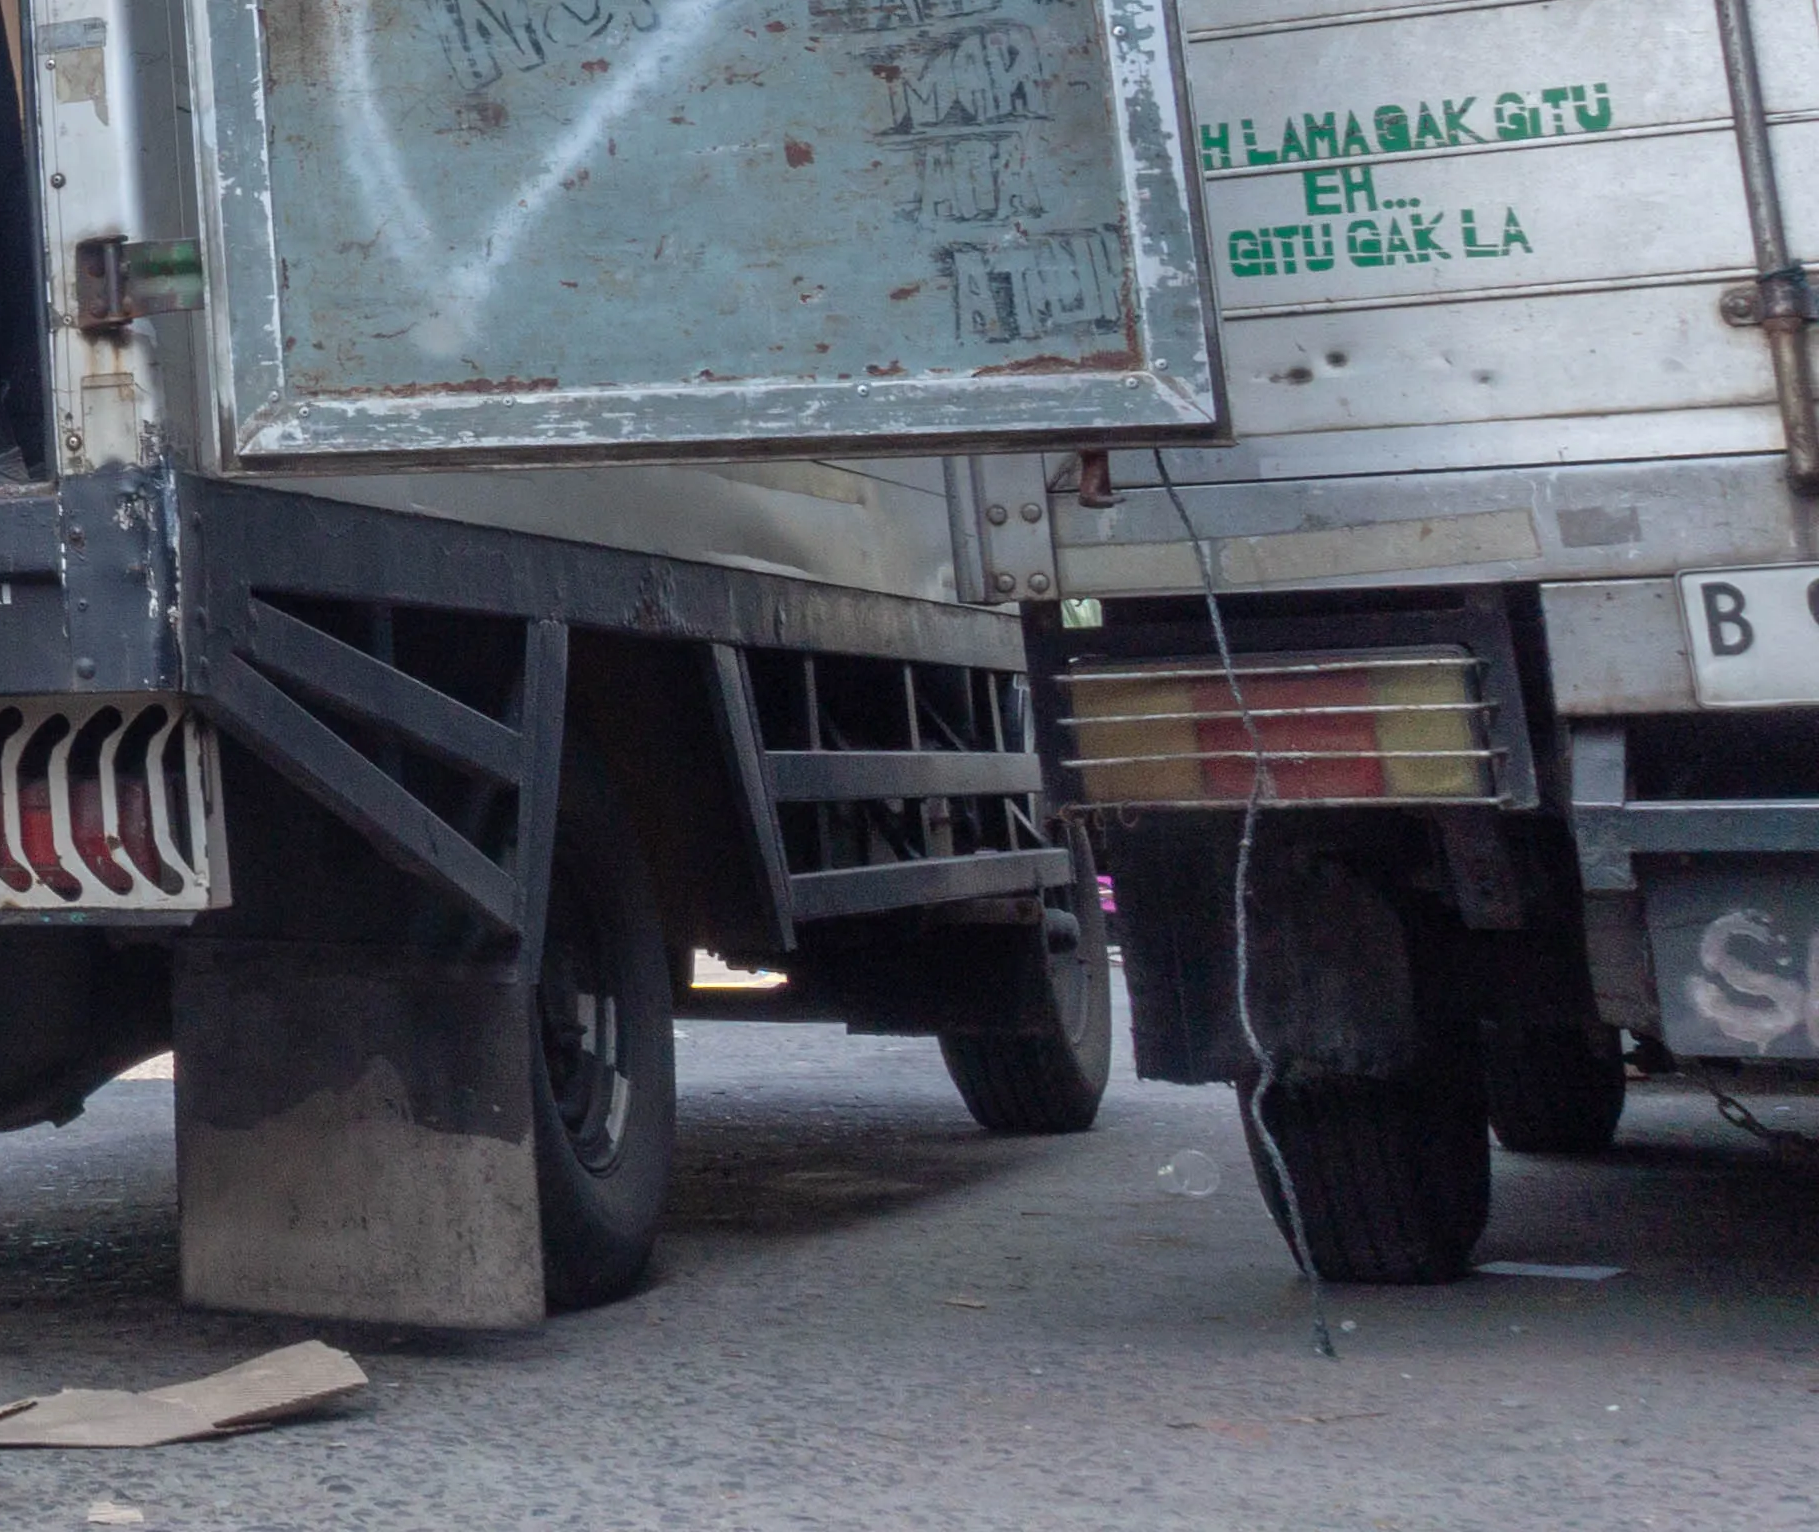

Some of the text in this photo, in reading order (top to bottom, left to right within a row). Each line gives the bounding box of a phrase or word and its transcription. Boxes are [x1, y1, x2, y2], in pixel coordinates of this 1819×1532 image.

[1494, 82, 1613, 140] GITU
[1228, 206, 1533, 277] GITU GAK LA
[1701, 581, 1755, 657] B
